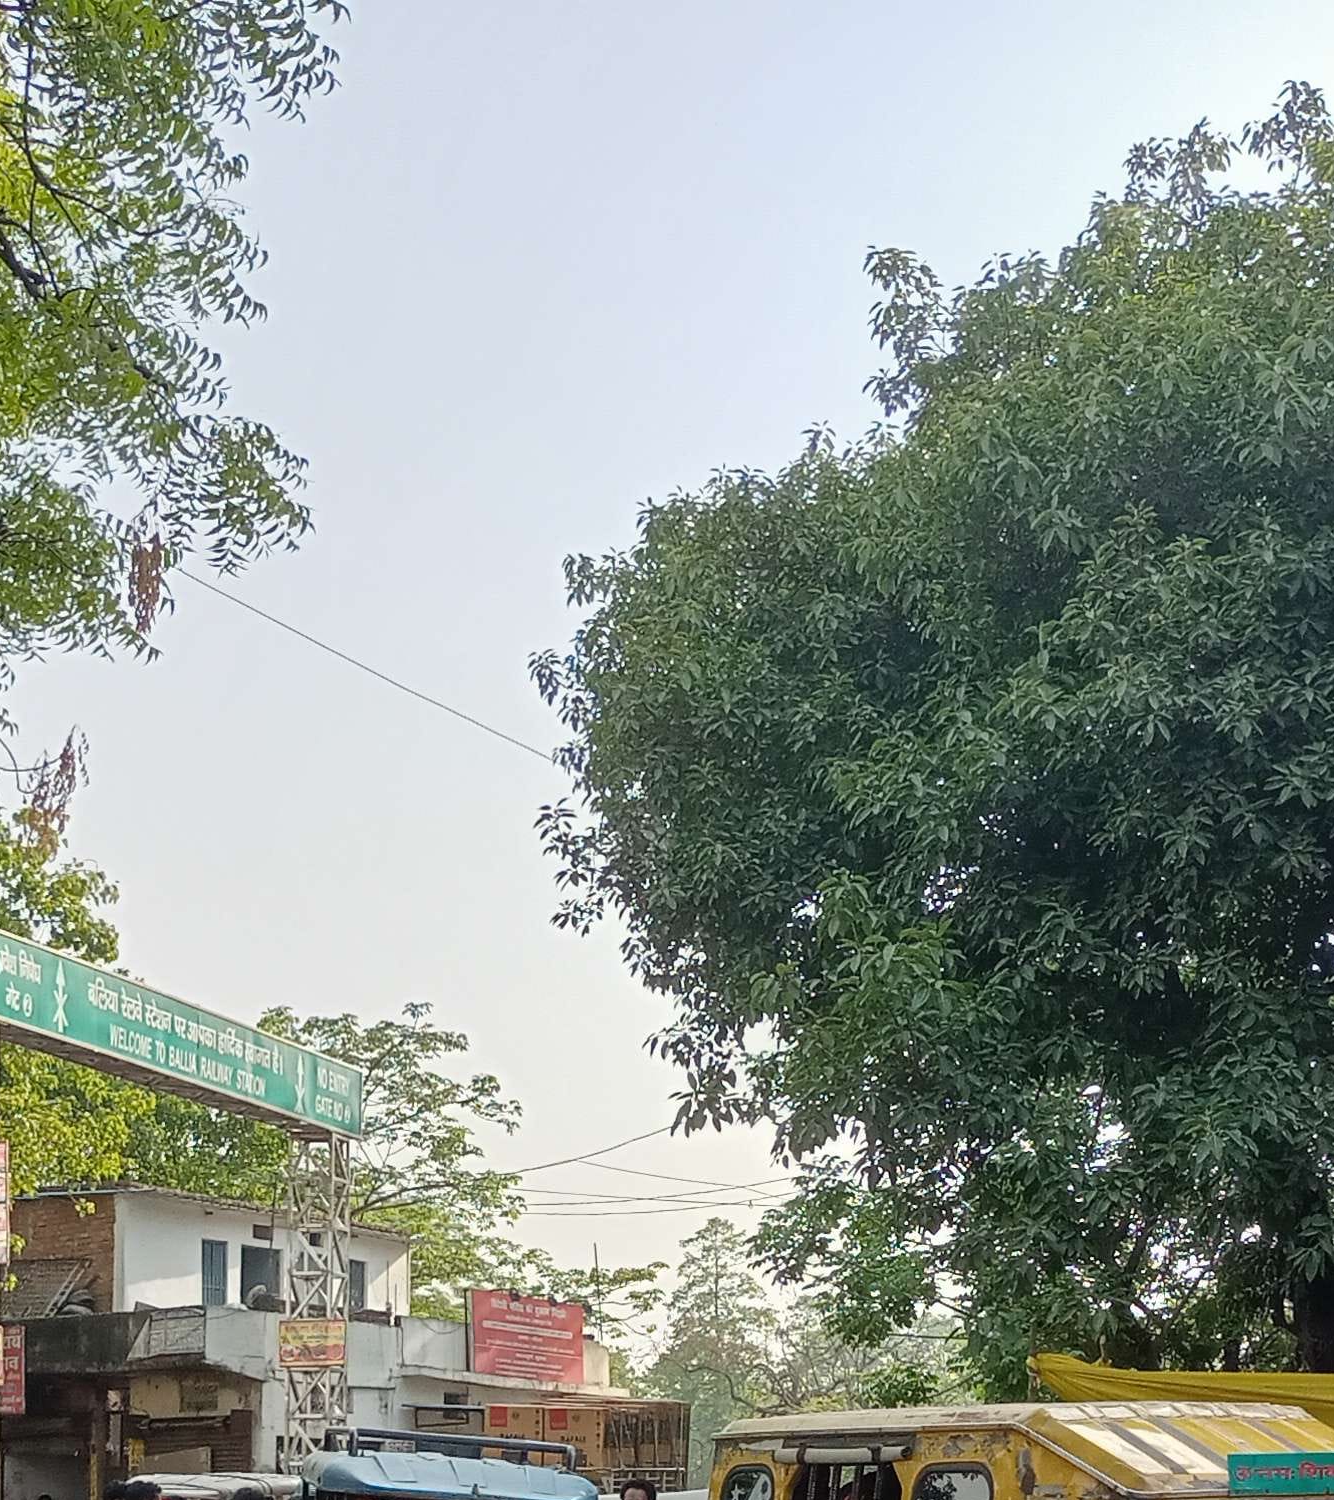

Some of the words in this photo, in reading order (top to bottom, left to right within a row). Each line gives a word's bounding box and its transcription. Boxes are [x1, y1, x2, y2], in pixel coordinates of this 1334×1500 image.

[121, 986, 142, 1023] रेलवे
[145, 998, 172, 1033] स्टेशन
[174, 1015, 187, 1039] पर
[110, 1024, 152, 1059] WELCOME
[155, 1039, 165, 1065] TO
[169, 1046, 197, 1074] BALLIA
[200, 1054, 234, 1086] RAILWAY
[236, 1069, 266, 1097] STATION
[317, 1066, 328, 1090] NO
[329, 1070, 350, 1097] ENTRY
[315, 1094, 333, 1119] GATE
